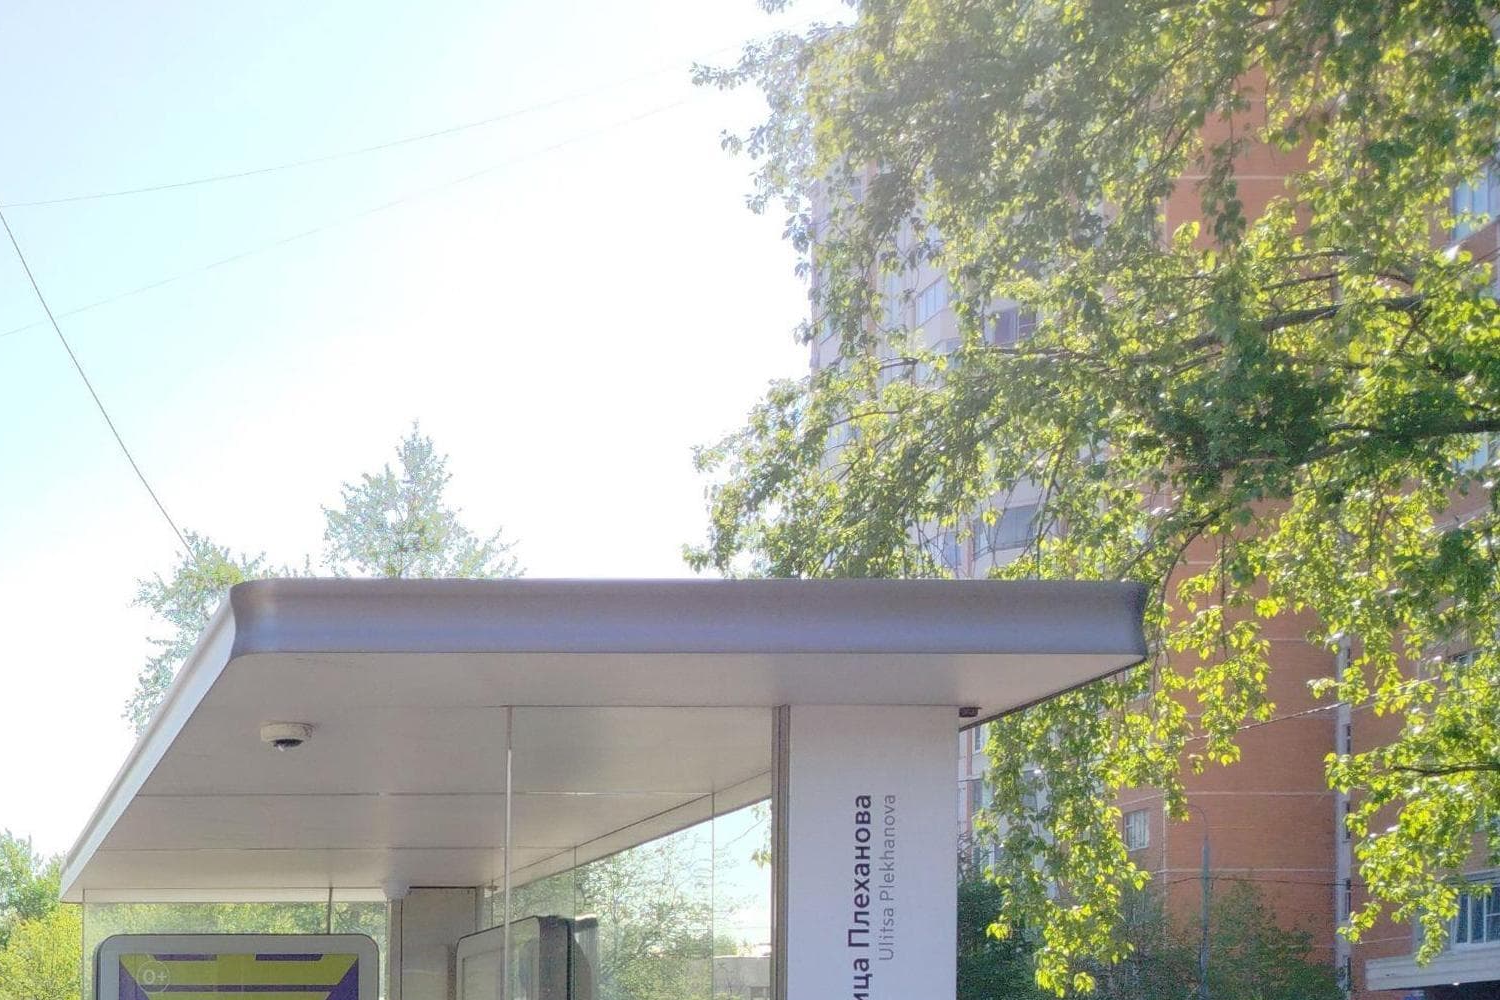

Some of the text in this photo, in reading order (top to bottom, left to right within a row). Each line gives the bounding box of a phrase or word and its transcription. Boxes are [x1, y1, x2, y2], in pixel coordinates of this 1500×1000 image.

[847, 794, 872, 948] Плеханова
[878, 794, 896, 961] Ulitsa Plekhanova
[142, 969, 168, 985] 0+
